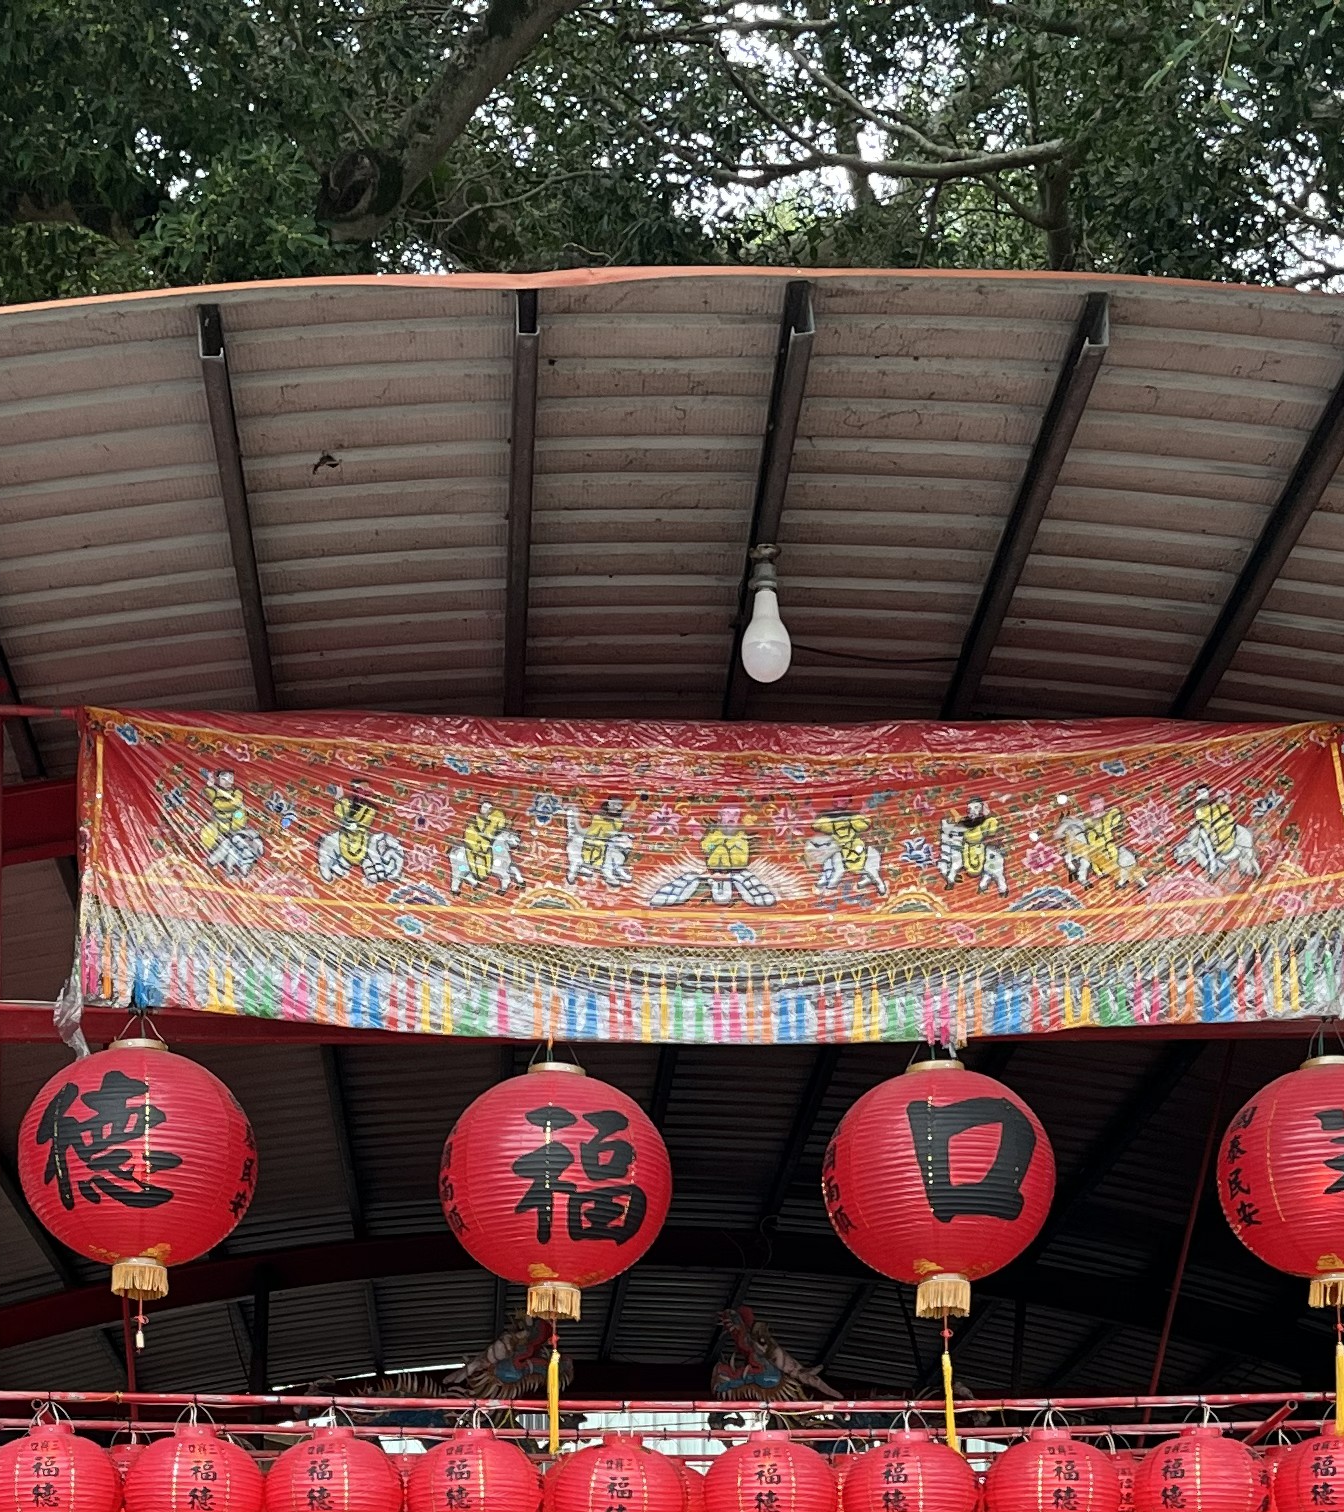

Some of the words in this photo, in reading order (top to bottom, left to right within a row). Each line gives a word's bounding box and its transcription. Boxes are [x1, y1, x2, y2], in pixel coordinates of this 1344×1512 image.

[36, 1070, 184, 1211] 德
[511, 1105, 648, 1247] 福
[905, 1096, 1037, 1224] 口
